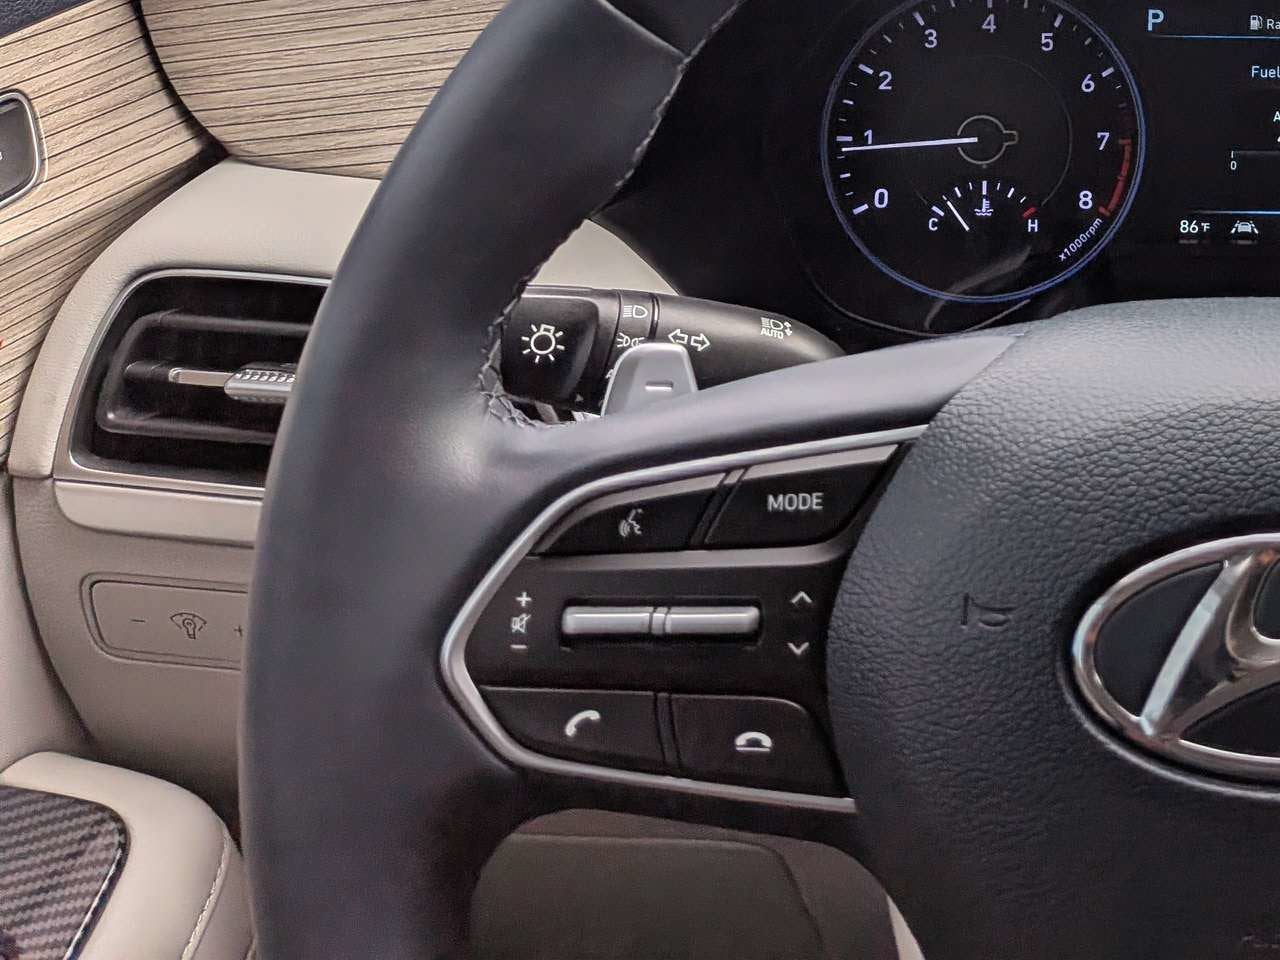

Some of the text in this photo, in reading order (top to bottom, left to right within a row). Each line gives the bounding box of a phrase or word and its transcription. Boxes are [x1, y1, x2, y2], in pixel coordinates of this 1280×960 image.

[981, 14, 997, 33] 4
[1147, 9, 1165, 31] P
[924, 29, 938, 49] 3
[1041, 32, 1054, 52] 5
[878, 70, 893, 91] 2
[1251, 65, 1280, 79] Fuel
[1081, 73, 1096, 93] 6
[863, 129, 874, 145] 1
[1096, 131, 1110, 151] 7
[1230, 160, 1237, 171] 0
[874, 188, 890, 209] 0
[1078, 190, 1094, 210] 8
[928, 217, 939, 232] C
[1027, 219, 1039, 233] H
[1058, 217, 1103, 262] x1000rpm
[760, 326, 784, 340] AUTO
[766, 492, 823, 512] MODE
